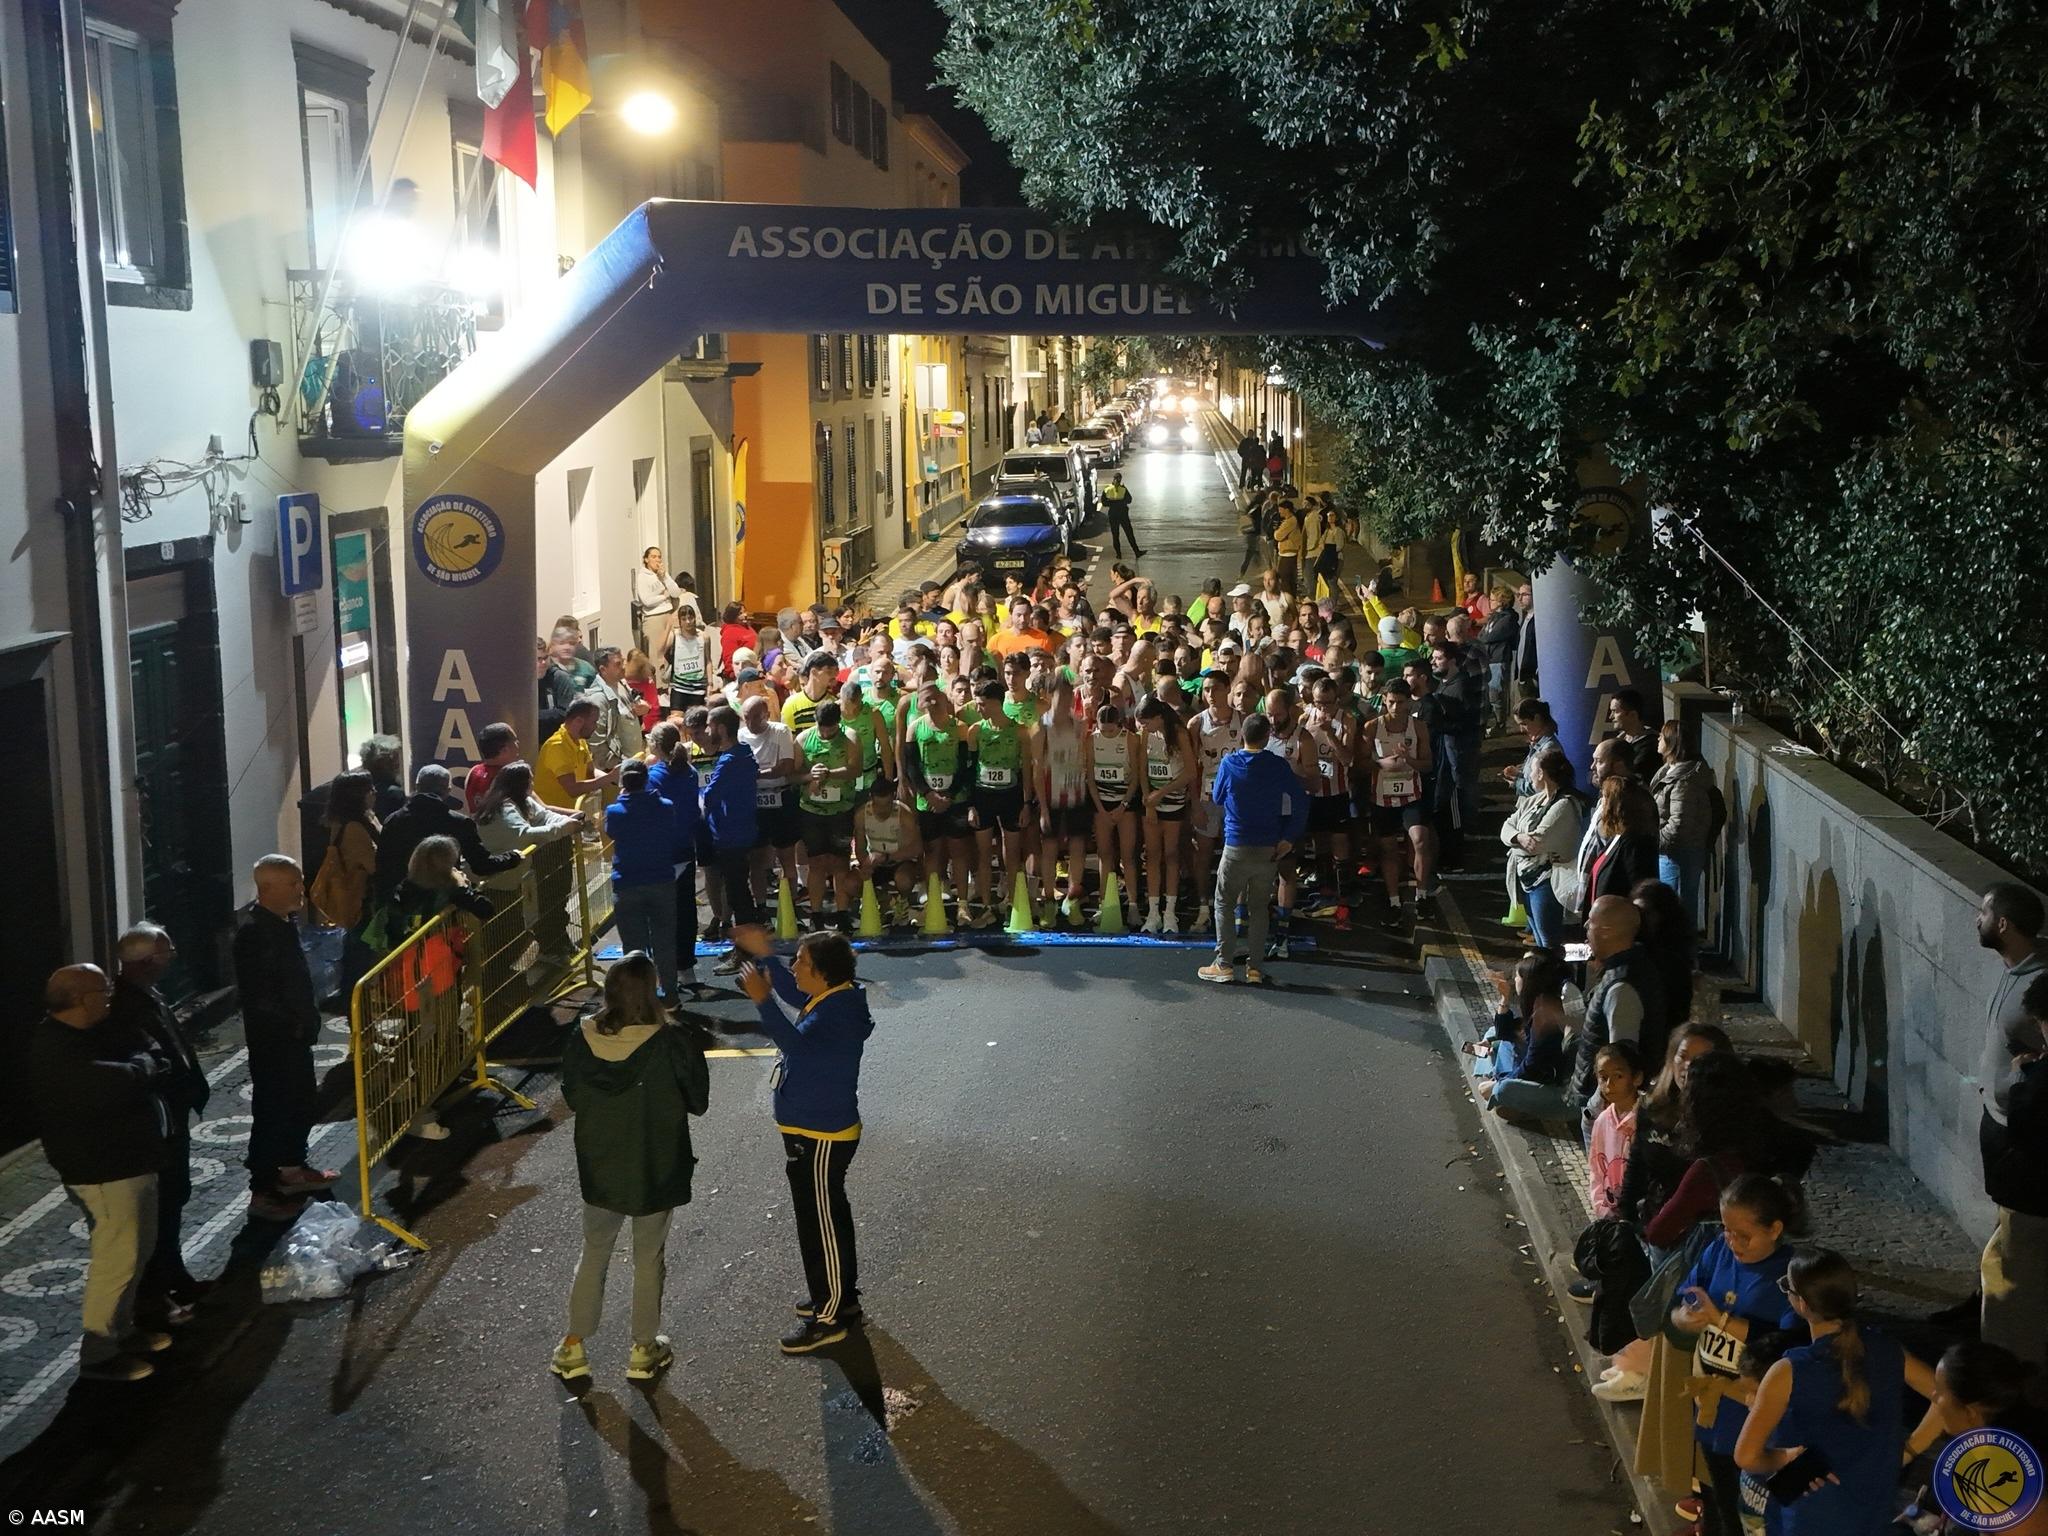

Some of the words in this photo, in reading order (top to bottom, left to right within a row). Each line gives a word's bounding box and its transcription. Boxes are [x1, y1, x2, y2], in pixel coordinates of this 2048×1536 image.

[728, 223, 1012, 270] ASSOCIAÇÃO
[1025, 228, 1080, 261] DE
[866, 283, 924, 315] DE
[935, 275, 1022, 315] SÃO
[417, 501, 452, 534] ASSOCIAÇÃO
[452, 501, 464, 510] DE
[464, 504, 497, 538] ATLETISMO
[288, 505, 313, 585] P
[426, 563, 437, 575] DE
[435, 570, 451, 581] SÃO
[451, 567, 481, 582] MIGUEL
[682, 661, 699, 671] 1331
[931, 777, 944, 788] 33
[988, 771, 1004, 781] 128
[1100, 769, 1118, 779] 454
[1393, 783, 1404, 793] 57
[1703, 1330, 1736, 1362] 1721
